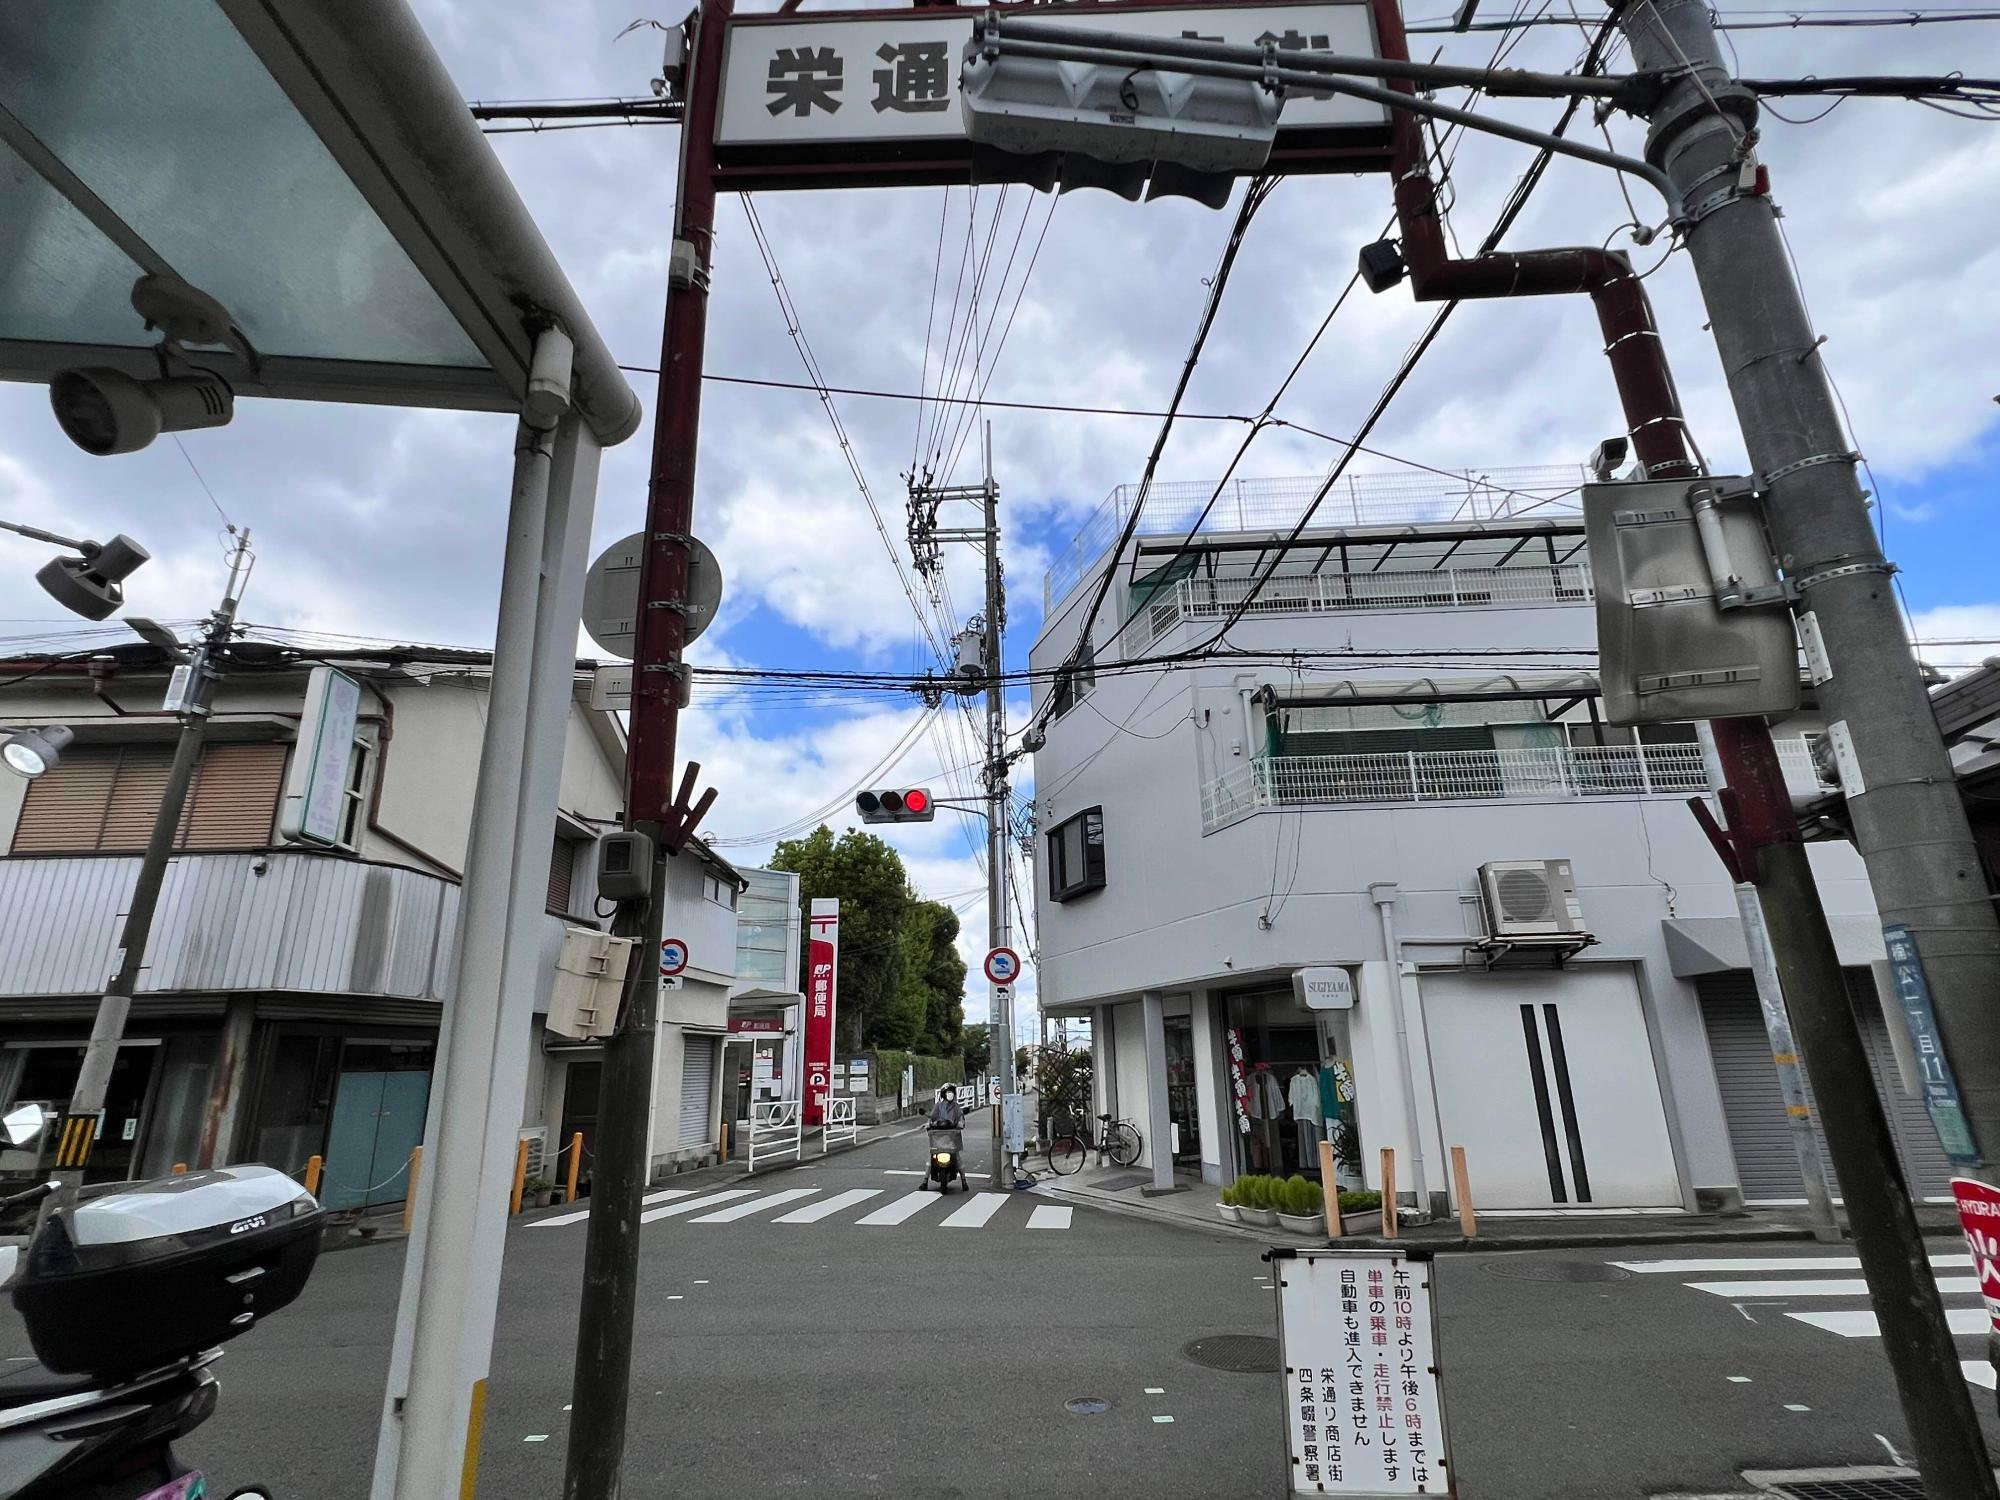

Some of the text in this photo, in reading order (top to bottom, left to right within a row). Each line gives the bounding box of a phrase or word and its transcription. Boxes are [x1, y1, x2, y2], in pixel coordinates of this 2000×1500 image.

[813, 979, 828, 1018] 郵便局
[1307, 981, 1350, 993] SUGIYAMA
[1920, 1056, 1945, 1080] 11
[230, 1215, 266, 1234] GIVI
[1960, 1199, 2000, 1217] HYDRA
[1340, 1269, 1370, 1447] 自動車も進入できません
[1367, 1269, 1400, 1482] 単車の乗車・走行禁止します
[1392, 1270, 1430, 1483] 午前10時より午後6時までは
[1298, 1368, 1320, 1482] 四条畷警察署
[1320, 1367, 1343, 1482] 栄通り商店街
